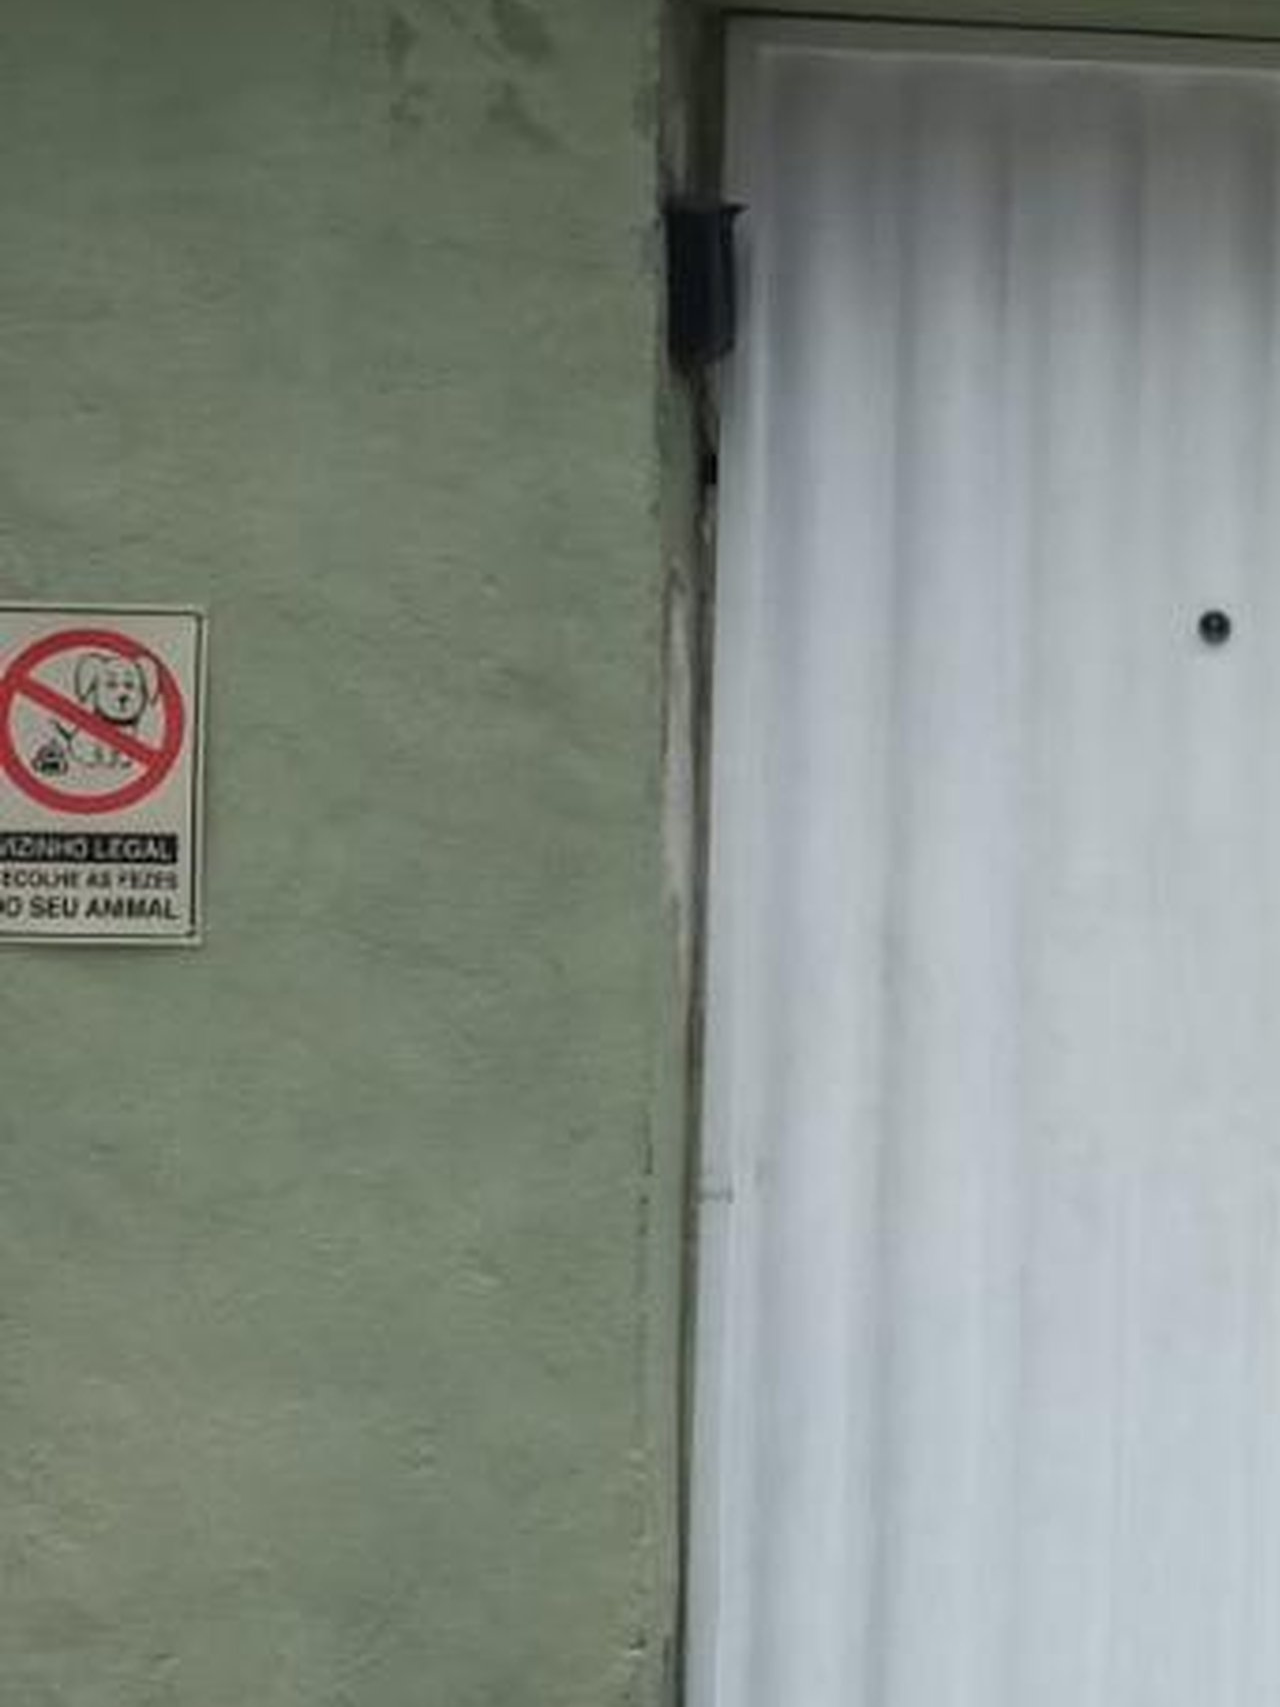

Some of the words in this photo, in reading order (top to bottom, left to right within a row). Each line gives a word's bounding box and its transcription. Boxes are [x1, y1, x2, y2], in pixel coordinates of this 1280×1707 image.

[94, 837, 174, 861] LEGAL
[0, 870, 78, 889] ECOLHE
[86, 871, 111, 889] AS
[117, 871, 179, 891] FEZES
[29, 895, 79, 919] SEU
[85, 897, 181, 921] ANIMAL
